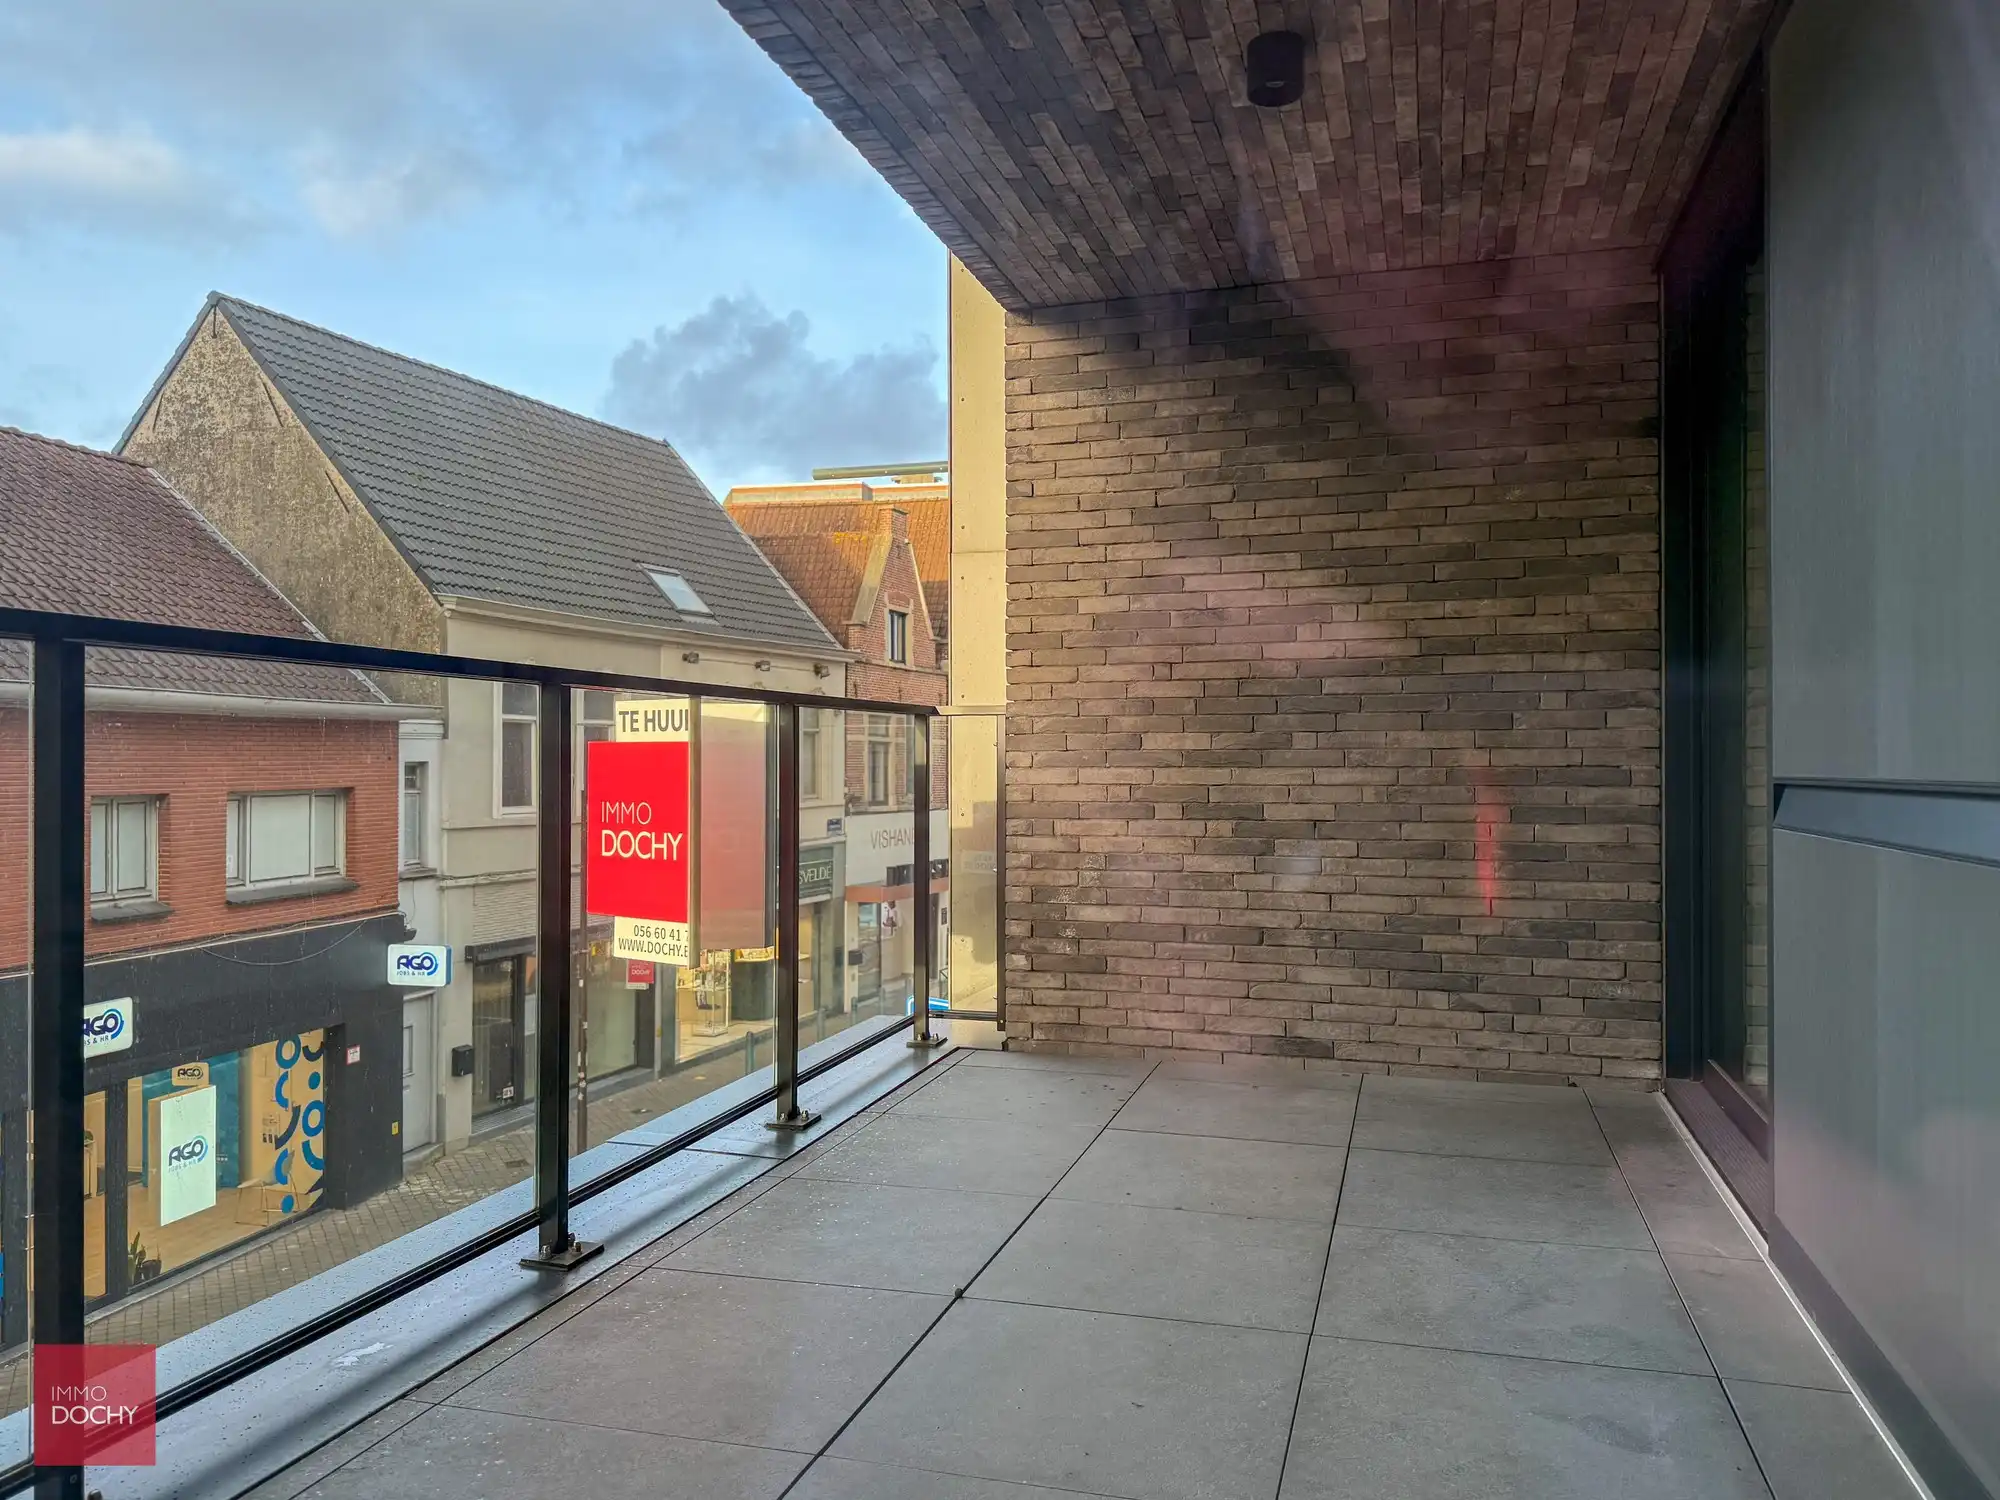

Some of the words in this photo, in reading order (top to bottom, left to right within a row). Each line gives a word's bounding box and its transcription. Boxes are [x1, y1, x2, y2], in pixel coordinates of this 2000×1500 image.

[619, 710, 640, 732] TE
[601, 801, 652, 825] IMMO
[601, 829, 683, 861] DOCHY
[633, 924, 652, 939] 056
[654, 927, 667, 940] 60
[669, 928, 681, 942] 41
[397, 953, 436, 971] AGO
[100, 1035, 109, 1043] HR
[177, 1067, 202, 1078] AGO
[168, 1138, 205, 1167] AGO
